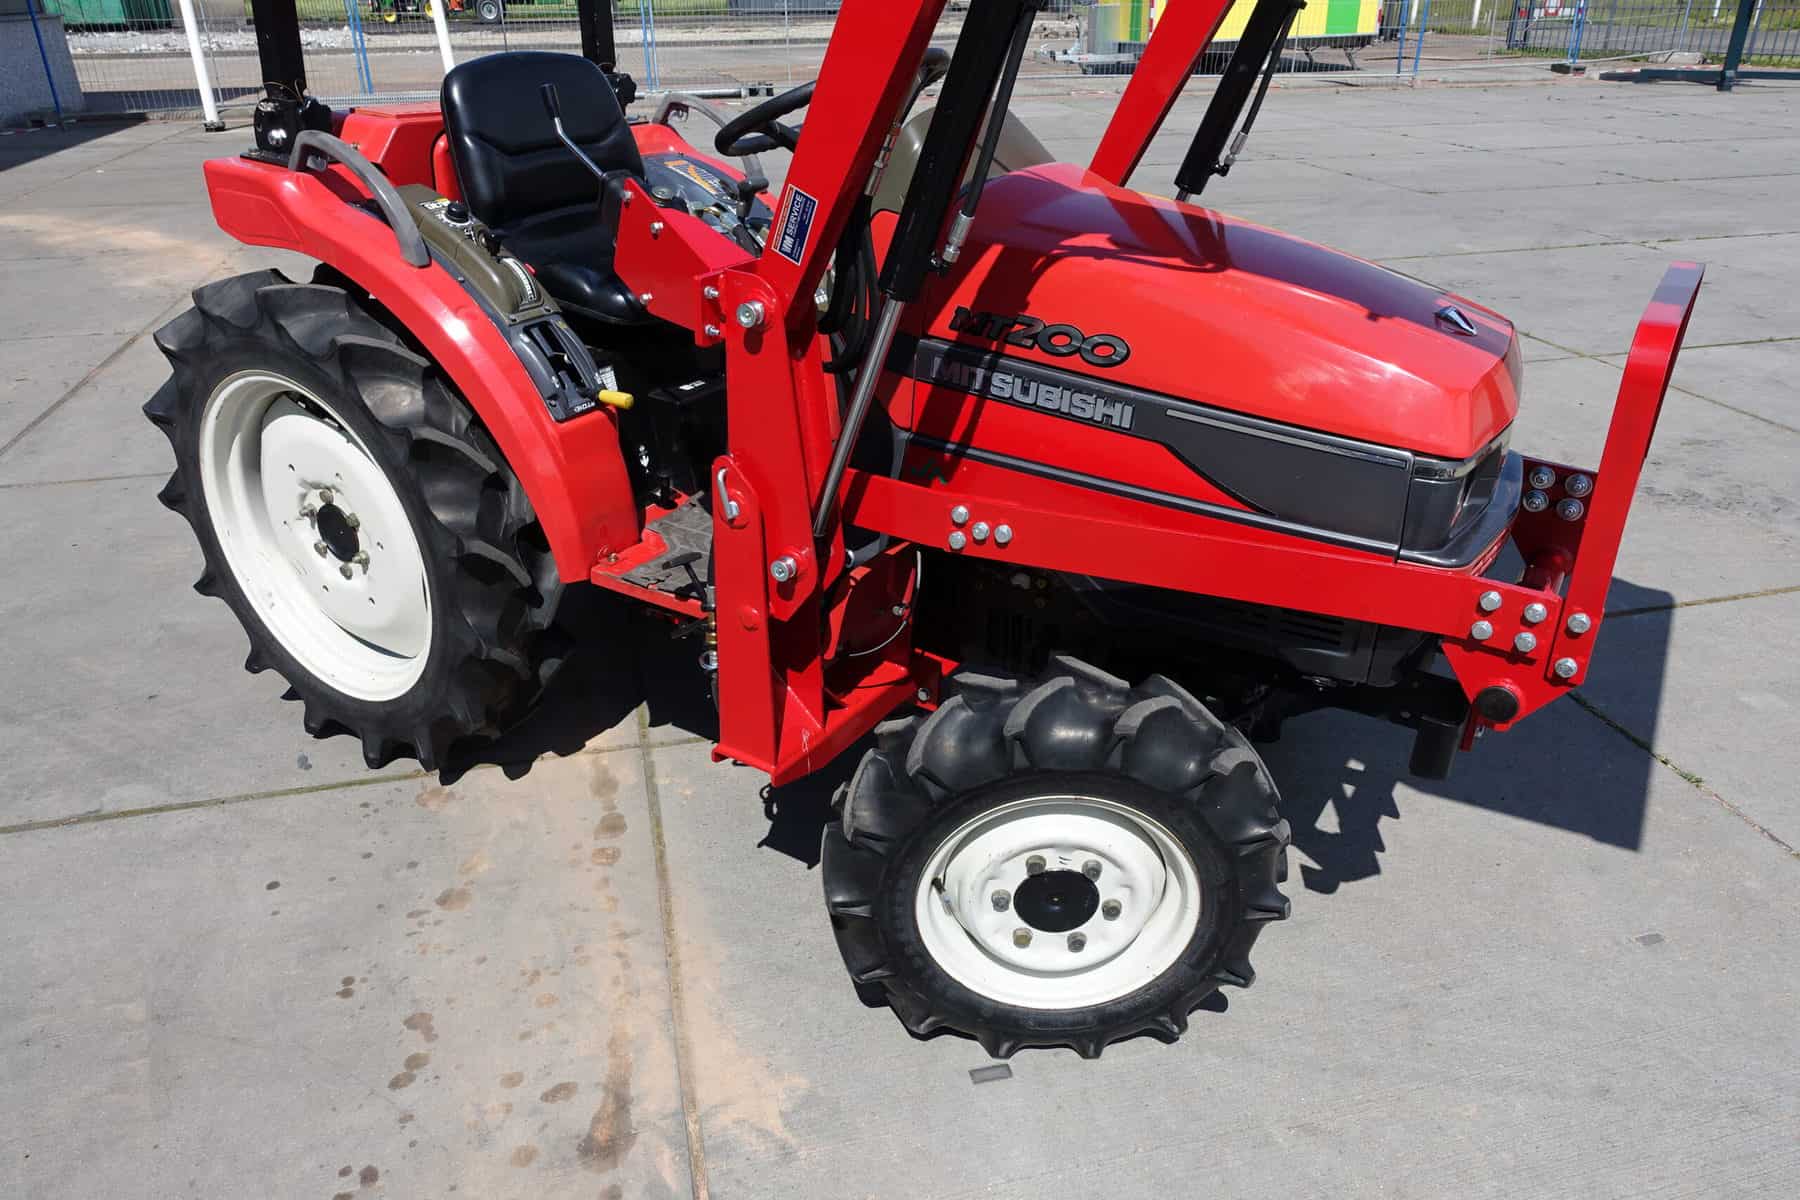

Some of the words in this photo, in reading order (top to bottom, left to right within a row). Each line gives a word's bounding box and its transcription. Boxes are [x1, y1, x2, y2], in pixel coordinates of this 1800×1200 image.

[786, 194, 803, 235] SERVICE
[948, 305, 1131, 368] MT200
[931, 355, 1135, 429] MITSUBISHI
